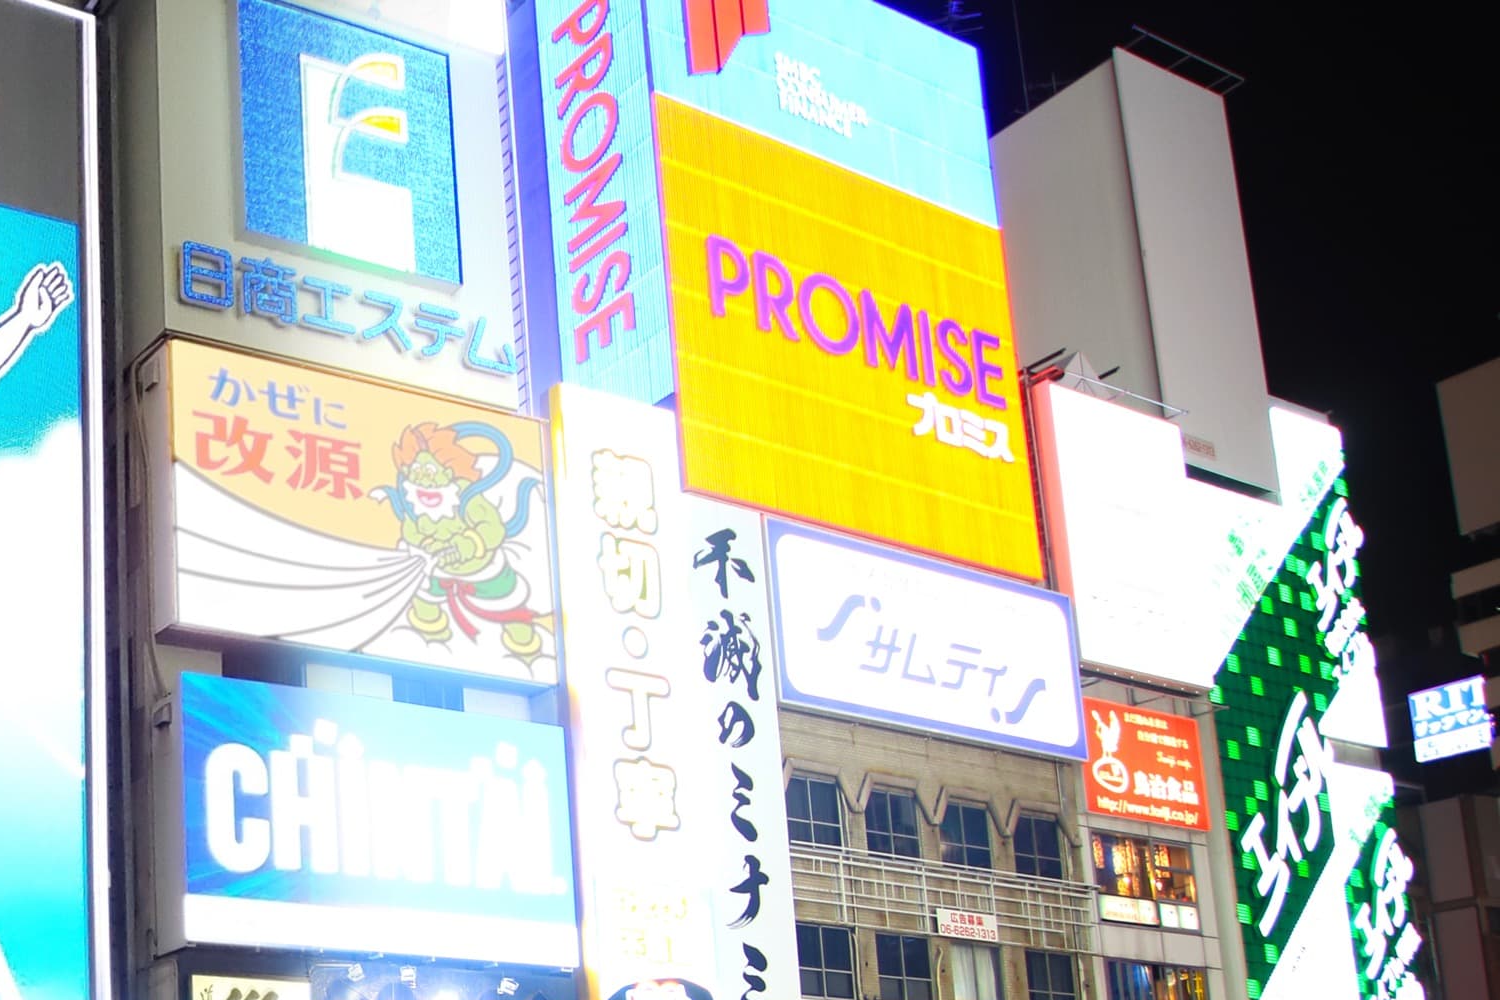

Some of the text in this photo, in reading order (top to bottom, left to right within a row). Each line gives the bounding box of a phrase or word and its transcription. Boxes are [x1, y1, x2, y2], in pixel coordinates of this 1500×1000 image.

[552, 0, 637, 364] PROMISE
[181, 240, 517, 376] 日商エステム
[706, 234, 1008, 409] PROMISE
[208, 367, 348, 430] かぜに
[907, 392, 1014, 462] プロミス
[192, 410, 364, 501] 改源
[860, 623, 1009, 697] サムティ
